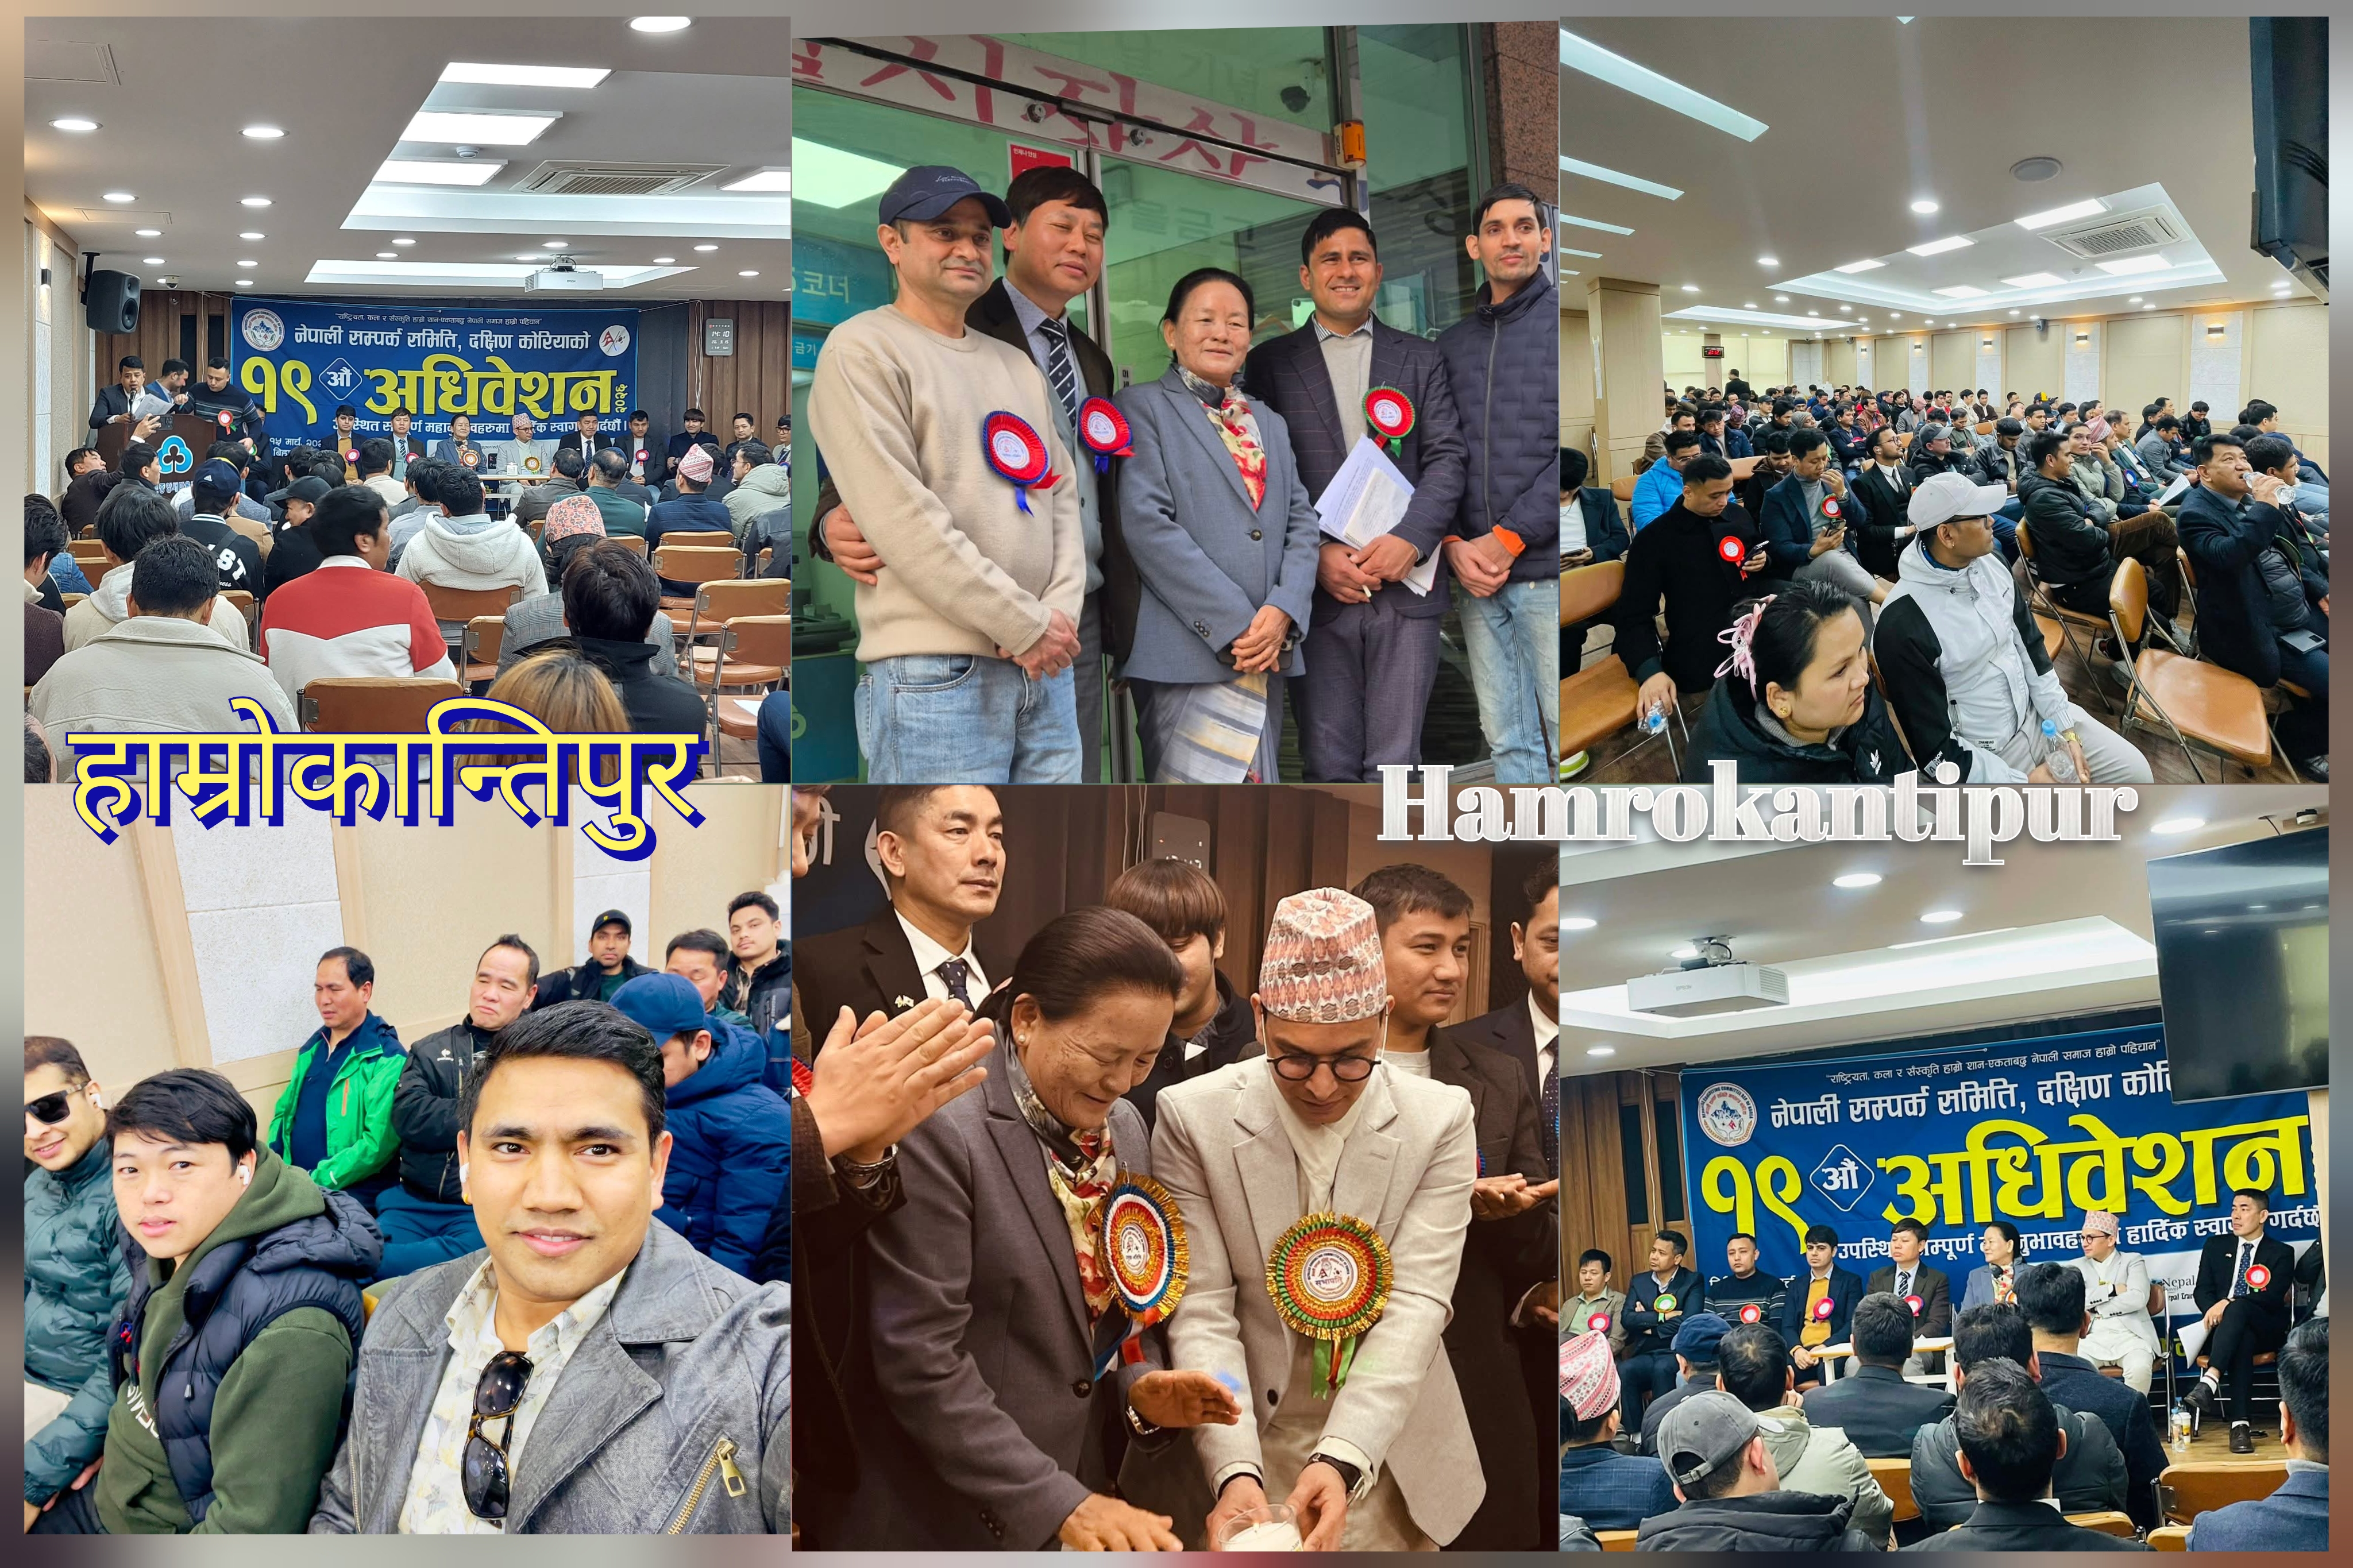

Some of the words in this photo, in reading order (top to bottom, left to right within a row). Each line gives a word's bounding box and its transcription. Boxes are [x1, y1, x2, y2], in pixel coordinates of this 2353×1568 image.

[467, 316, 483, 325] नेपाली
[295, 323, 344, 345] नेपाली
[349, 327, 403, 347] सम्पर्क
[407, 328, 461, 353] समिति,
[469, 330, 514, 353] दक्षिण
[518, 330, 591, 350] कोरियाको
[240, 356, 318, 425] १९
[364, 353, 618, 420] अधिवेशन
[615, 384, 628, 413] २०२६
[1873, 1069, 1893, 1079] कला
[1896, 1069, 1903, 1077] र
[1943, 1060, 1962, 1073] हाम्रो
[2031, 1051, 2059, 1063] नेपाली
[2062, 1049, 2092, 1060] समाज
[2095, 1044, 2116, 1058] हाम्रो
[1770, 1093, 1841, 1128] नेपाली
[1848, 1085, 1930, 1123] सम्पर्क
[1937, 1077, 2027, 1115] समिति,
[2037, 1071, 2113, 1109] दक्षिण
[1701, 1155, 1810, 1254] १९
[1876, 1113, 2309, 1226] अधिवेशन
[2126, 1218, 2188, 1245] हार्दिक
[2162, 1275, 2195, 1289] Nepal
